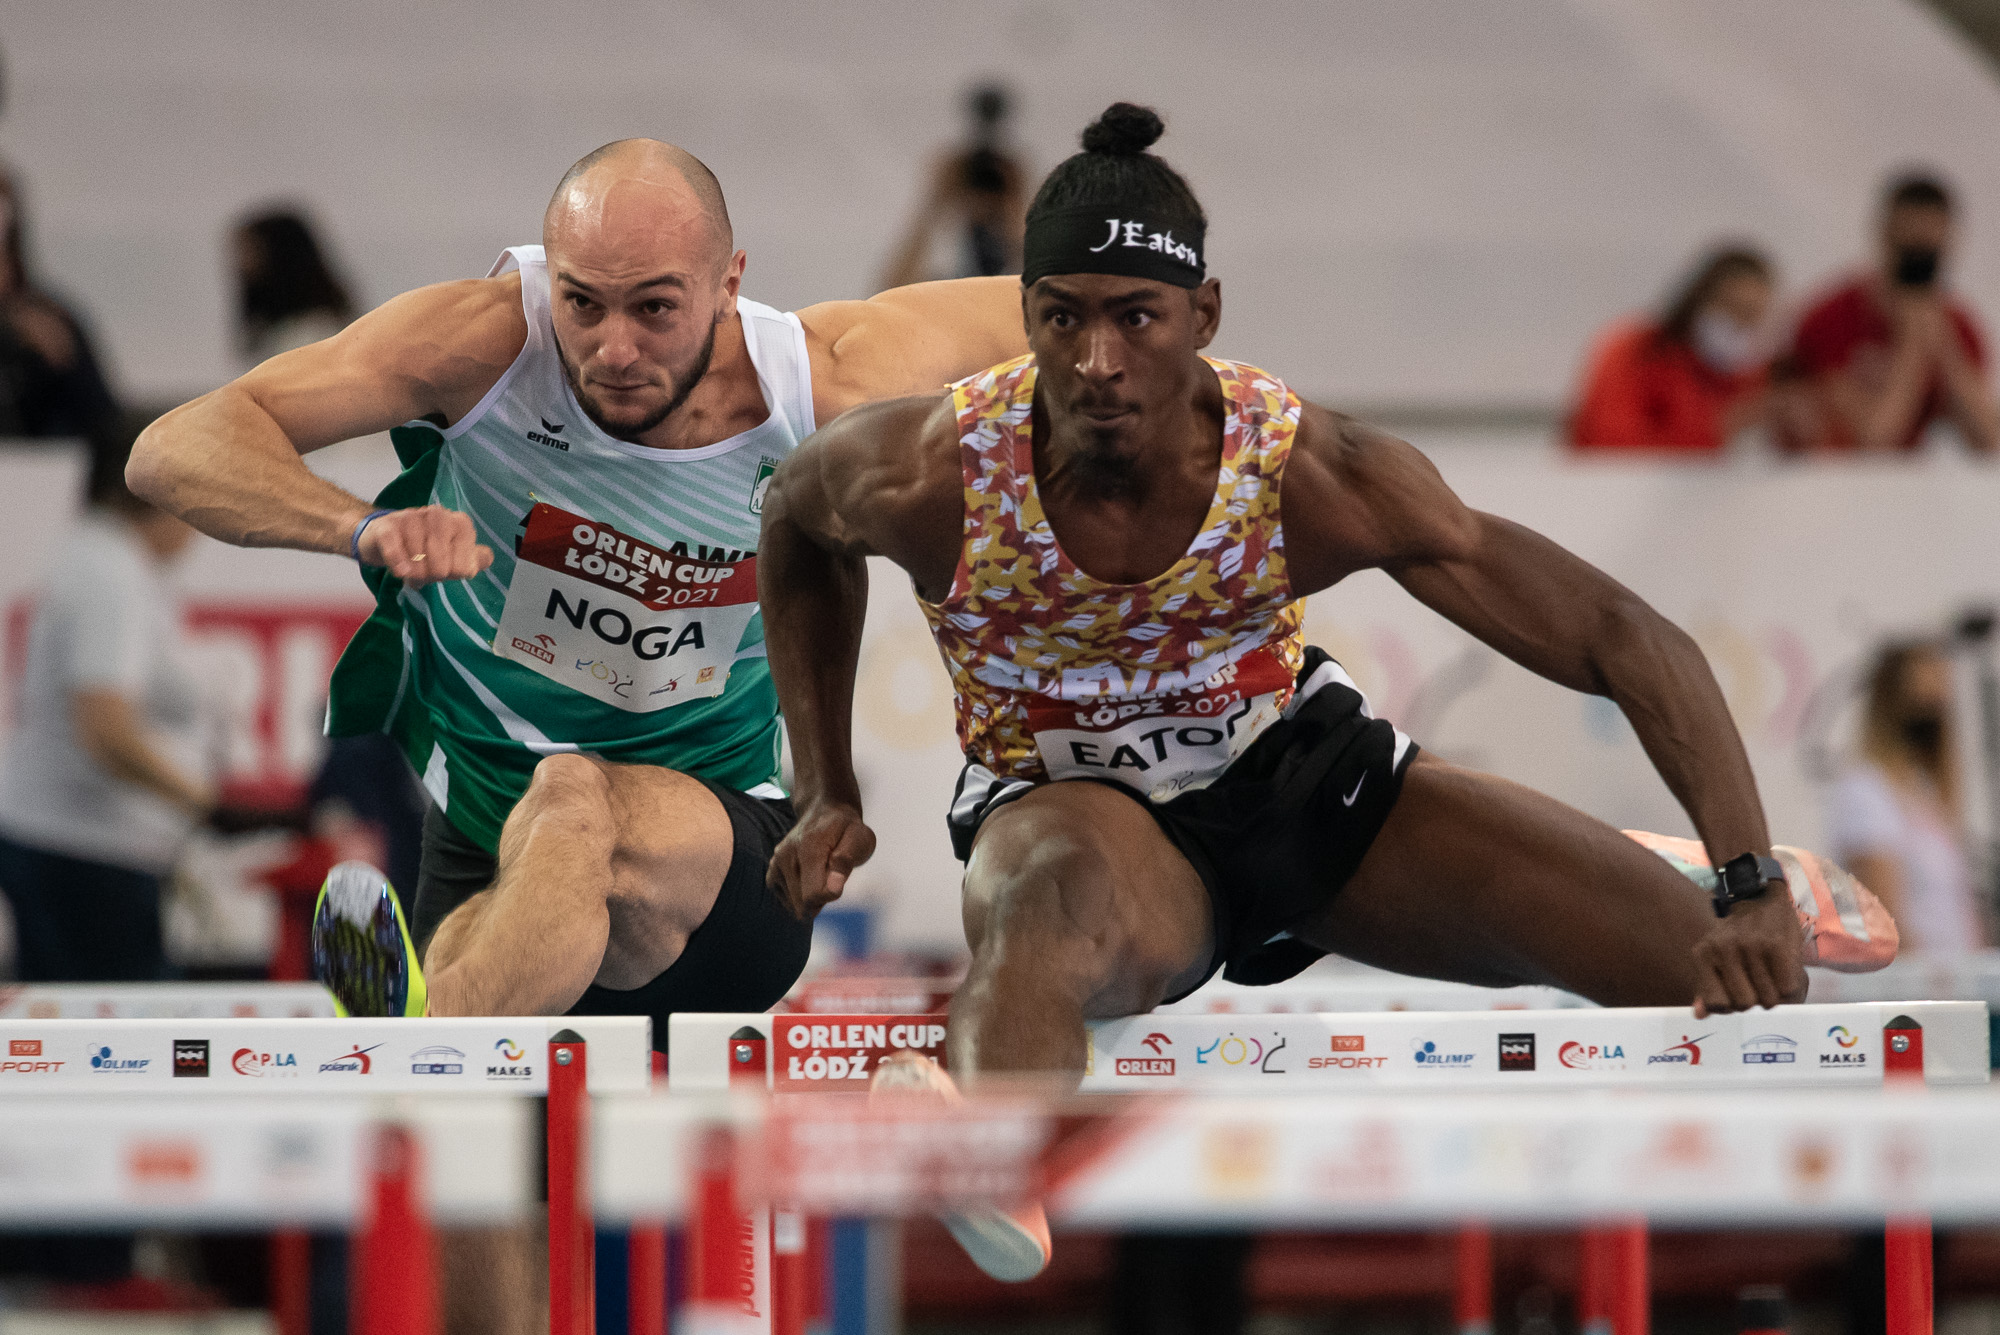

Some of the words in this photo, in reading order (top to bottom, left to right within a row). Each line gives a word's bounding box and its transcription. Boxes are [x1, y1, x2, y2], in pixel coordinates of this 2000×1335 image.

[526, 430, 570, 451] erima
[572, 524, 672, 579] ORLEN
[674, 564, 735, 584] CUP
[564, 547, 650, 594] ŁÓDŹ
[653, 585, 719, 605] 2021
[545, 588, 706, 661] NOGA
[513, 638, 554, 664] ORLEN
[787, 1024, 886, 1049] ORLEN
[889, 1024, 946, 1049] CUP
[102, 1059, 151, 1069] OLIMP
[318, 1062, 360, 1074] polanik
[788, 1050, 869, 1080] ŁÓDŹ
[1117, 1060, 1174, 1074] ORLEN
[1308, 1057, 1389, 1069] SPORT
[1426, 1053, 1475, 1064] OLIMP
[1647, 1053, 1689, 1065] polanik
